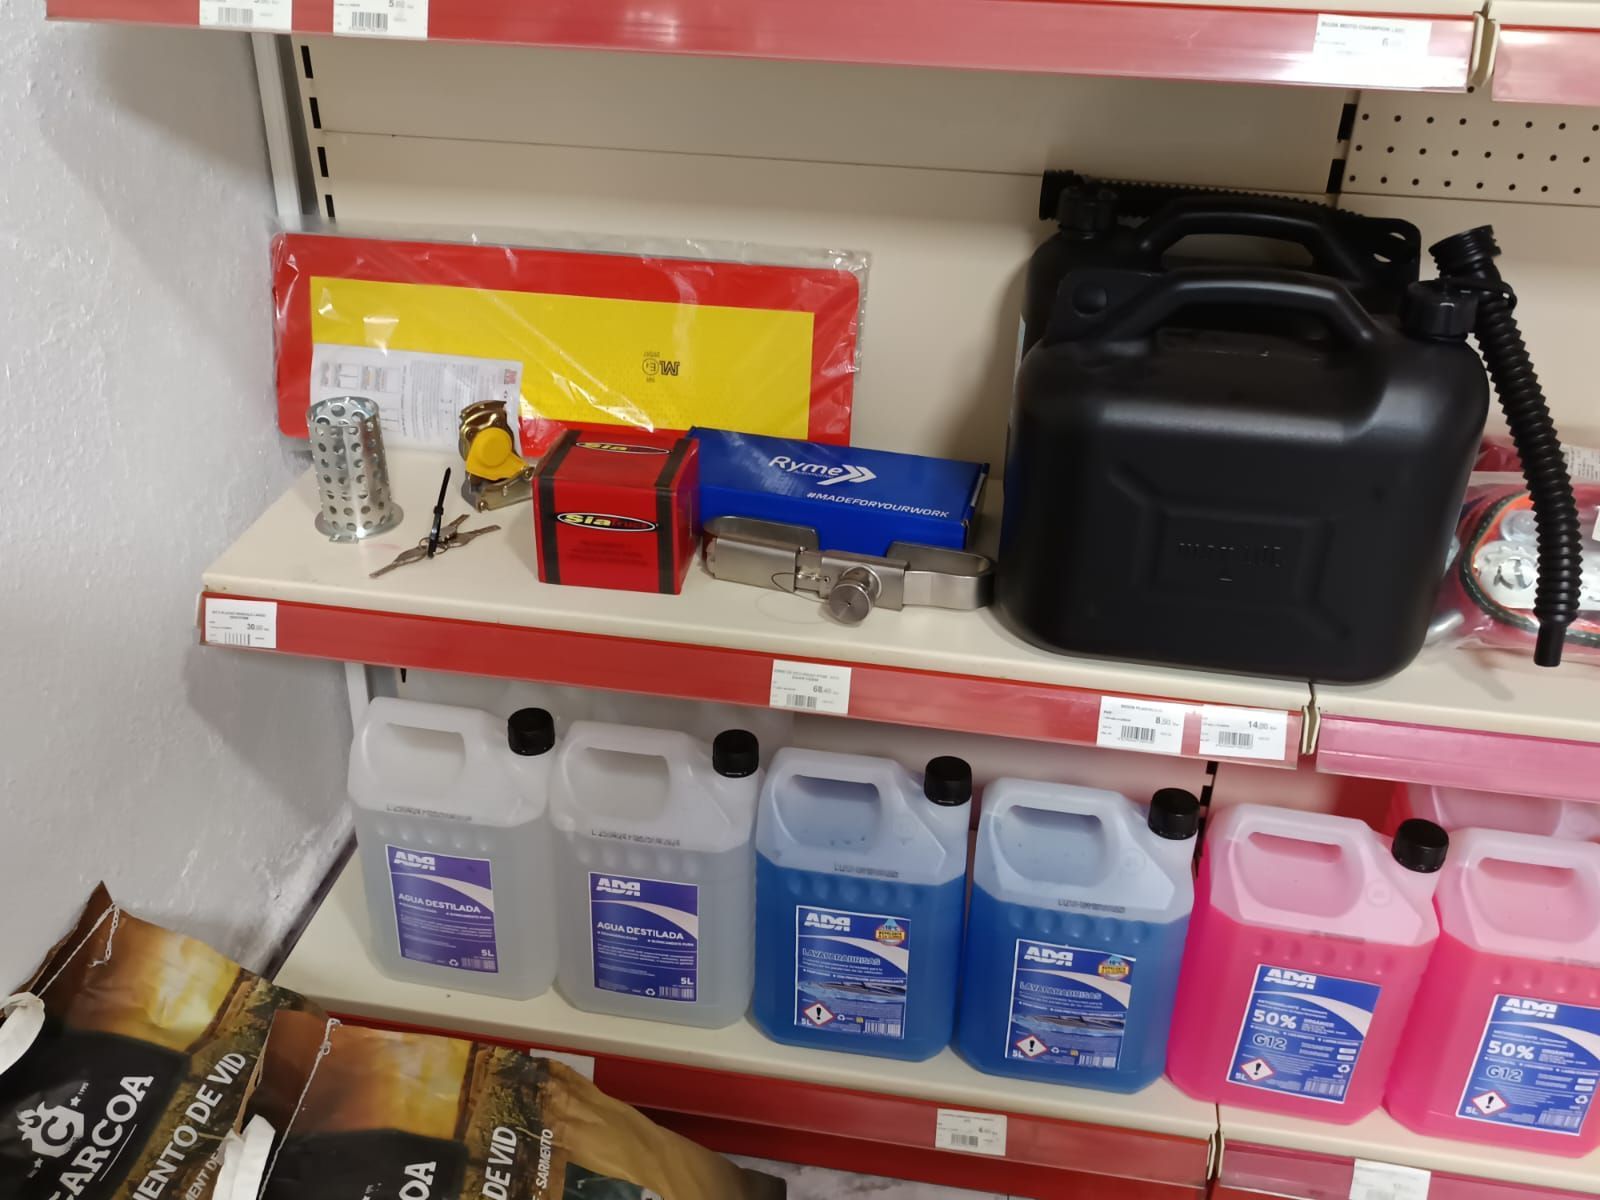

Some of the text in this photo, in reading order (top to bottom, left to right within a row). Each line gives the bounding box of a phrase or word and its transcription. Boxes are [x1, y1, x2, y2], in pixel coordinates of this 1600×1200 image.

[768, 456, 843, 476] Ryme
[806, 492, 950, 518] #MADEFORYOURWORK
[398, 892, 481, 914] AGUA DESTILADA
[597, 921, 684, 940] AGUA DESTILADA
[481, 949, 494, 957] 5L
[680, 977, 694, 985] 5L
[1252, 1010, 1297, 1030] 50%
[1252, 1032, 1288, 1051] G12
[1487, 1040, 1534, 1060] 50%
[1486, 1064, 1524, 1083] G12
[185, 1084, 223, 1125] DE
[206, 1053, 246, 1085] VID
[482, 1126, 518, 1200] DE VID
